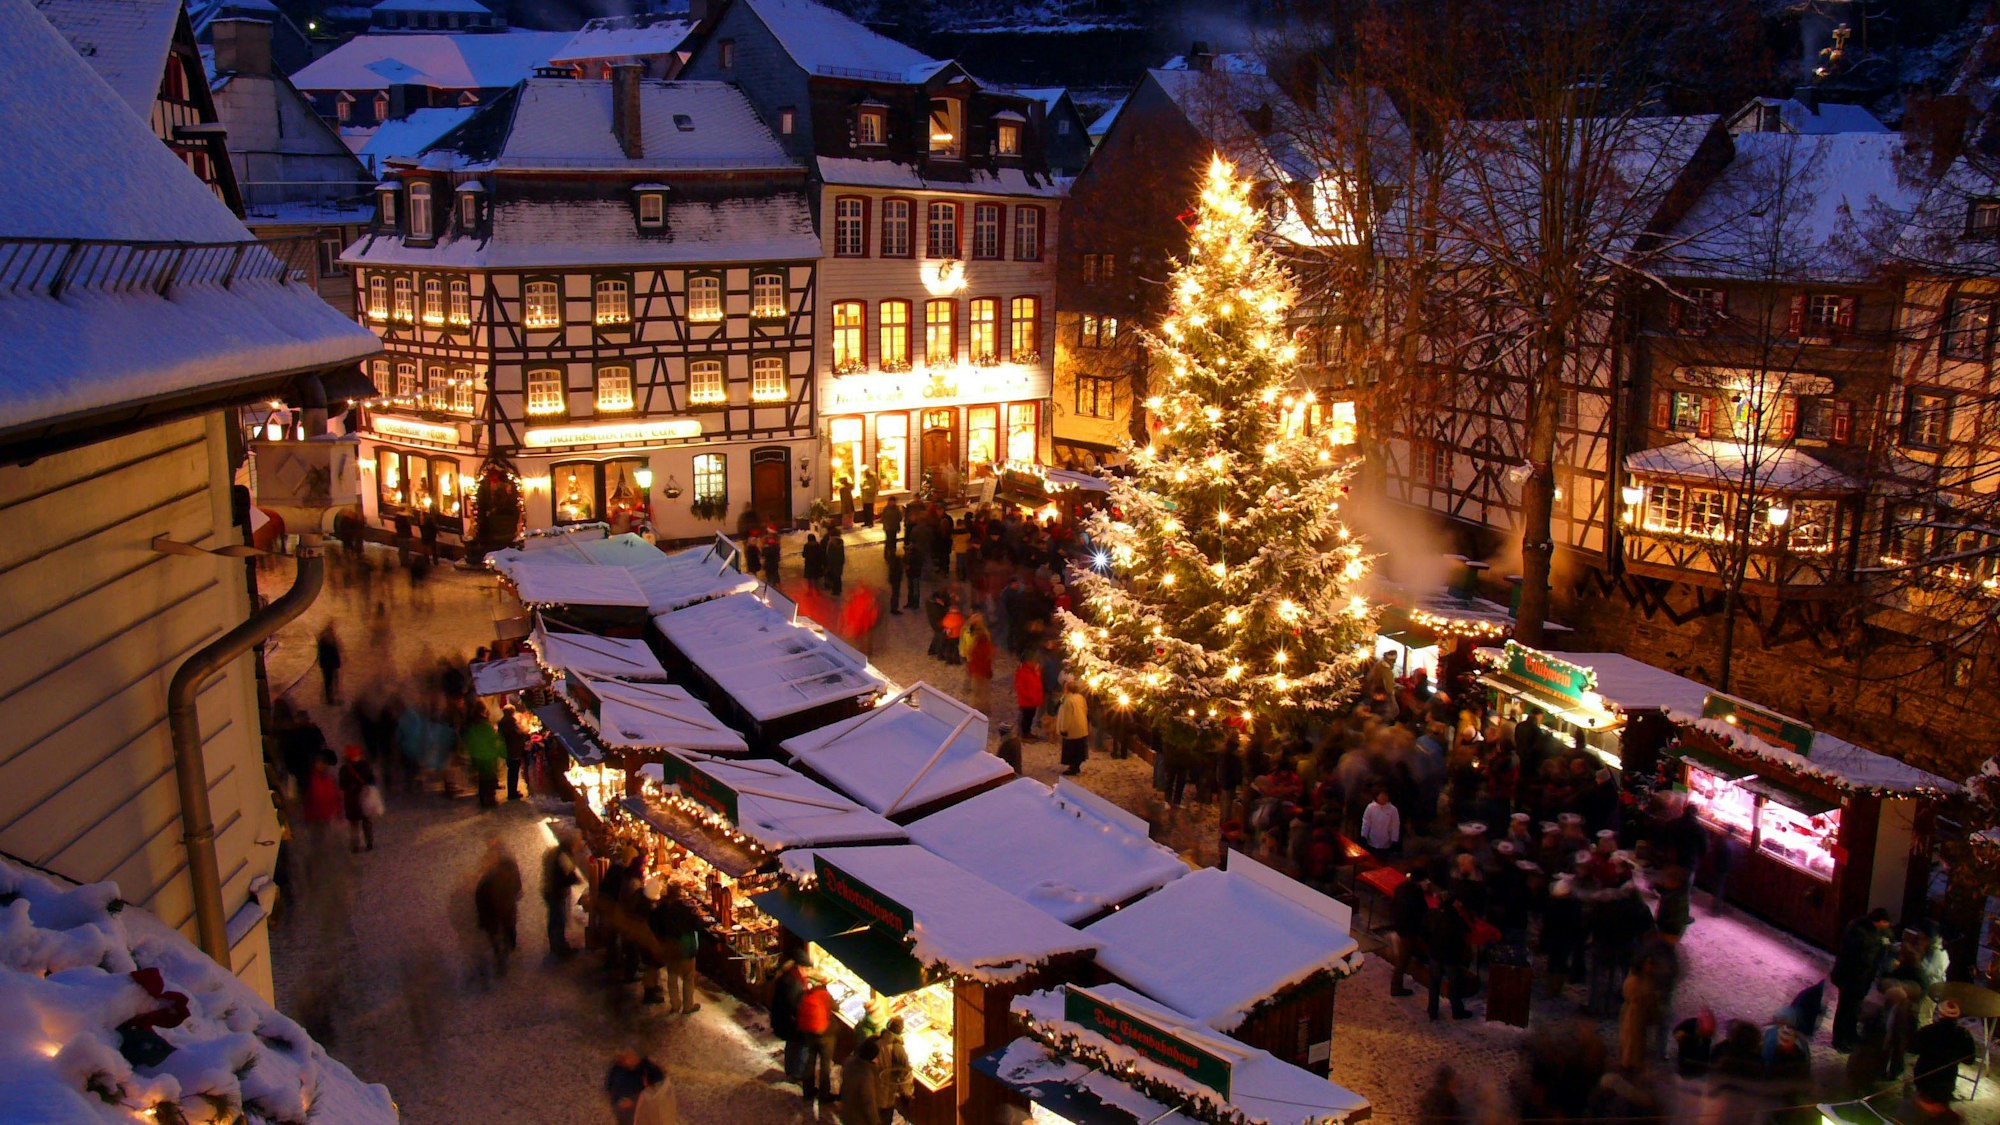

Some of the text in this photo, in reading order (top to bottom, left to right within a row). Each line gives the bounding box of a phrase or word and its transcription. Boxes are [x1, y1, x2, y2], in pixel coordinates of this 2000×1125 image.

[824, 866, 905, 933] Dekorationen
[1095, 1008, 1118, 1030] Das
[1120, 1020, 1199, 1070] Eisenbahnhaus
